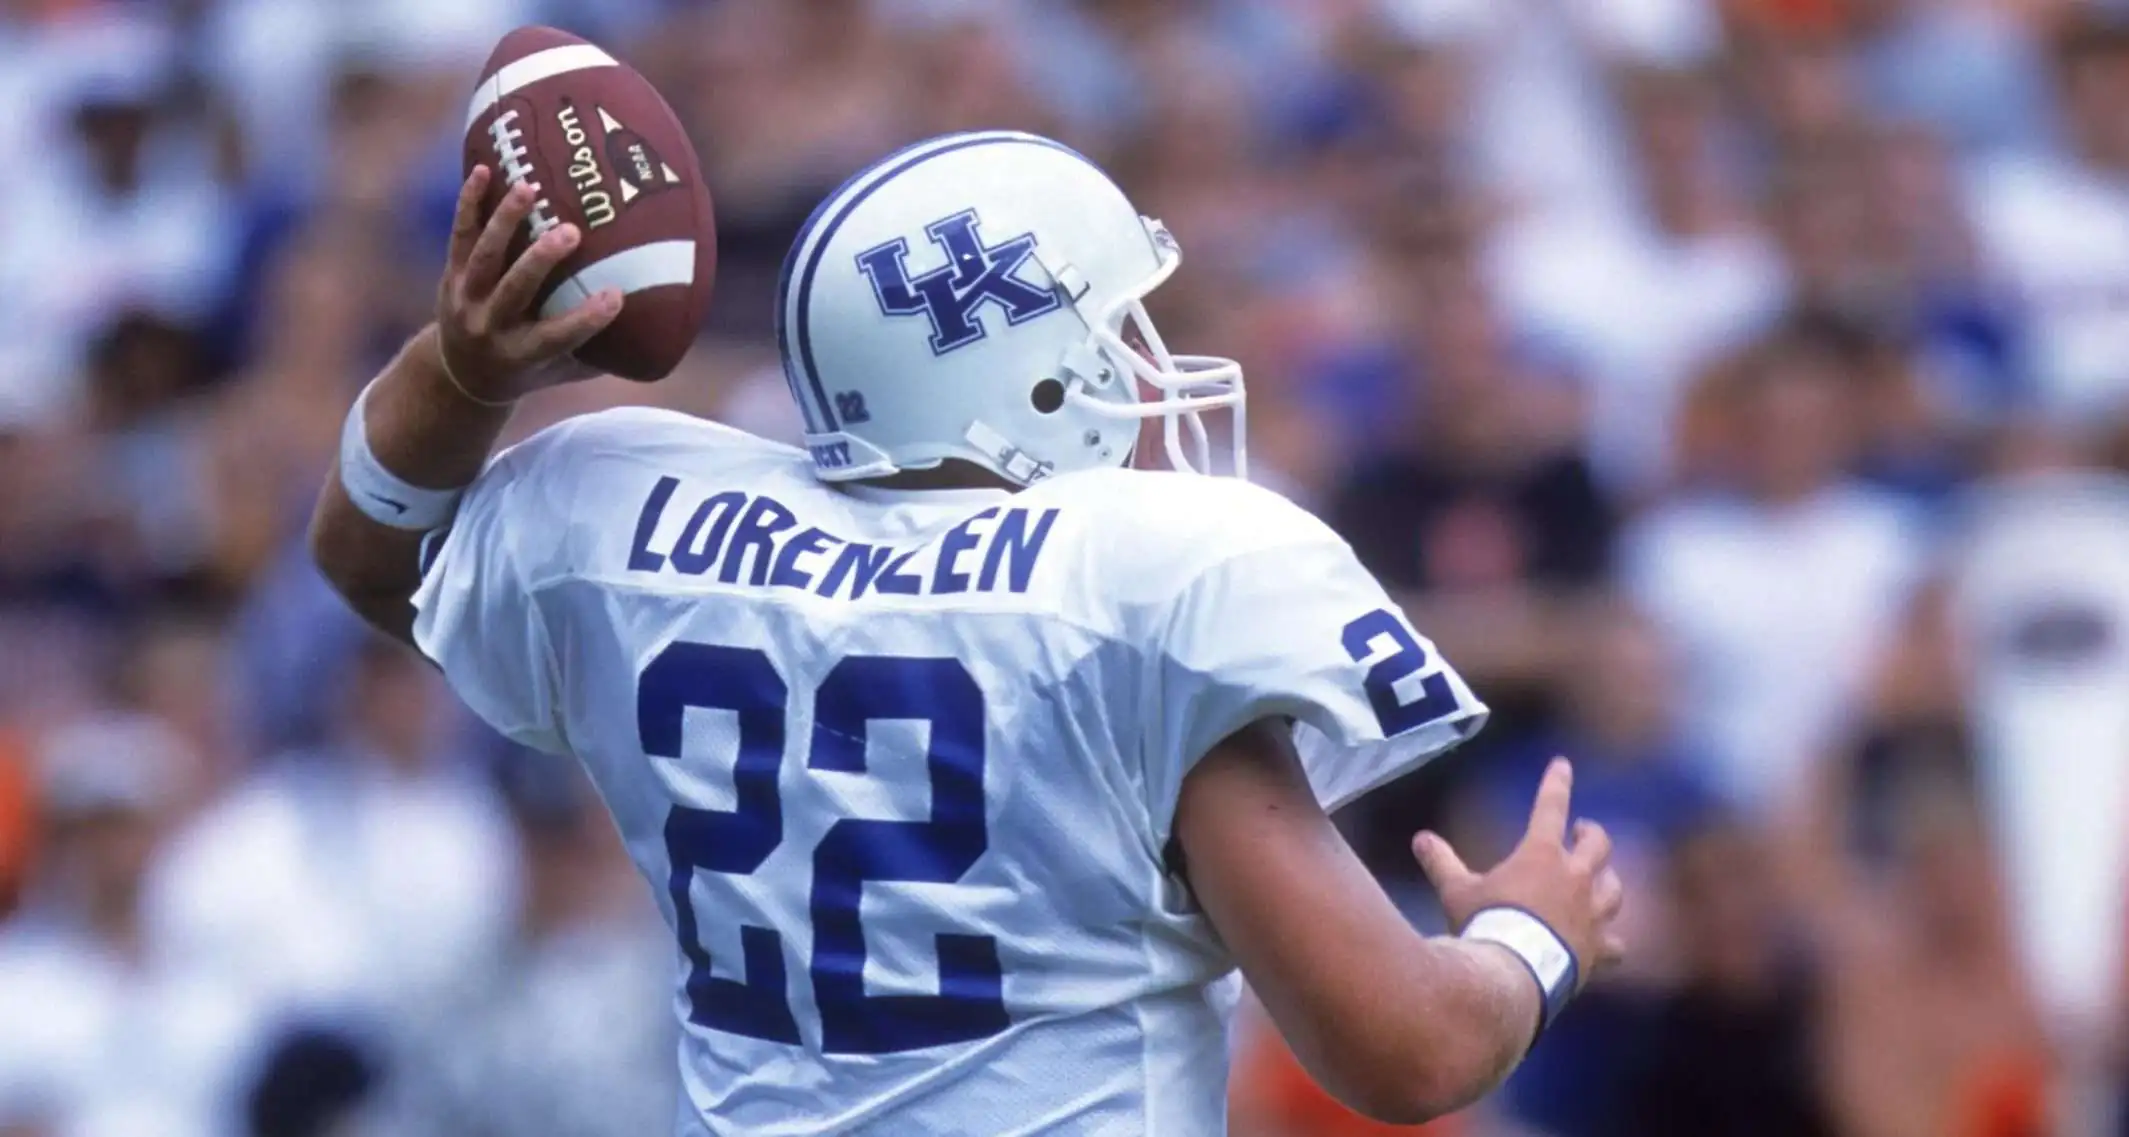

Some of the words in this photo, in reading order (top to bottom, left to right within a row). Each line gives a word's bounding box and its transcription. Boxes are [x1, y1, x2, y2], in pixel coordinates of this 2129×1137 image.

[557, 105, 616, 230] Wilson
[627, 143, 654, 181] NCAA
[855, 208, 1062, 356] UK
[834, 389, 870, 424] 22
[637, 640, 1011, 1055] 22
